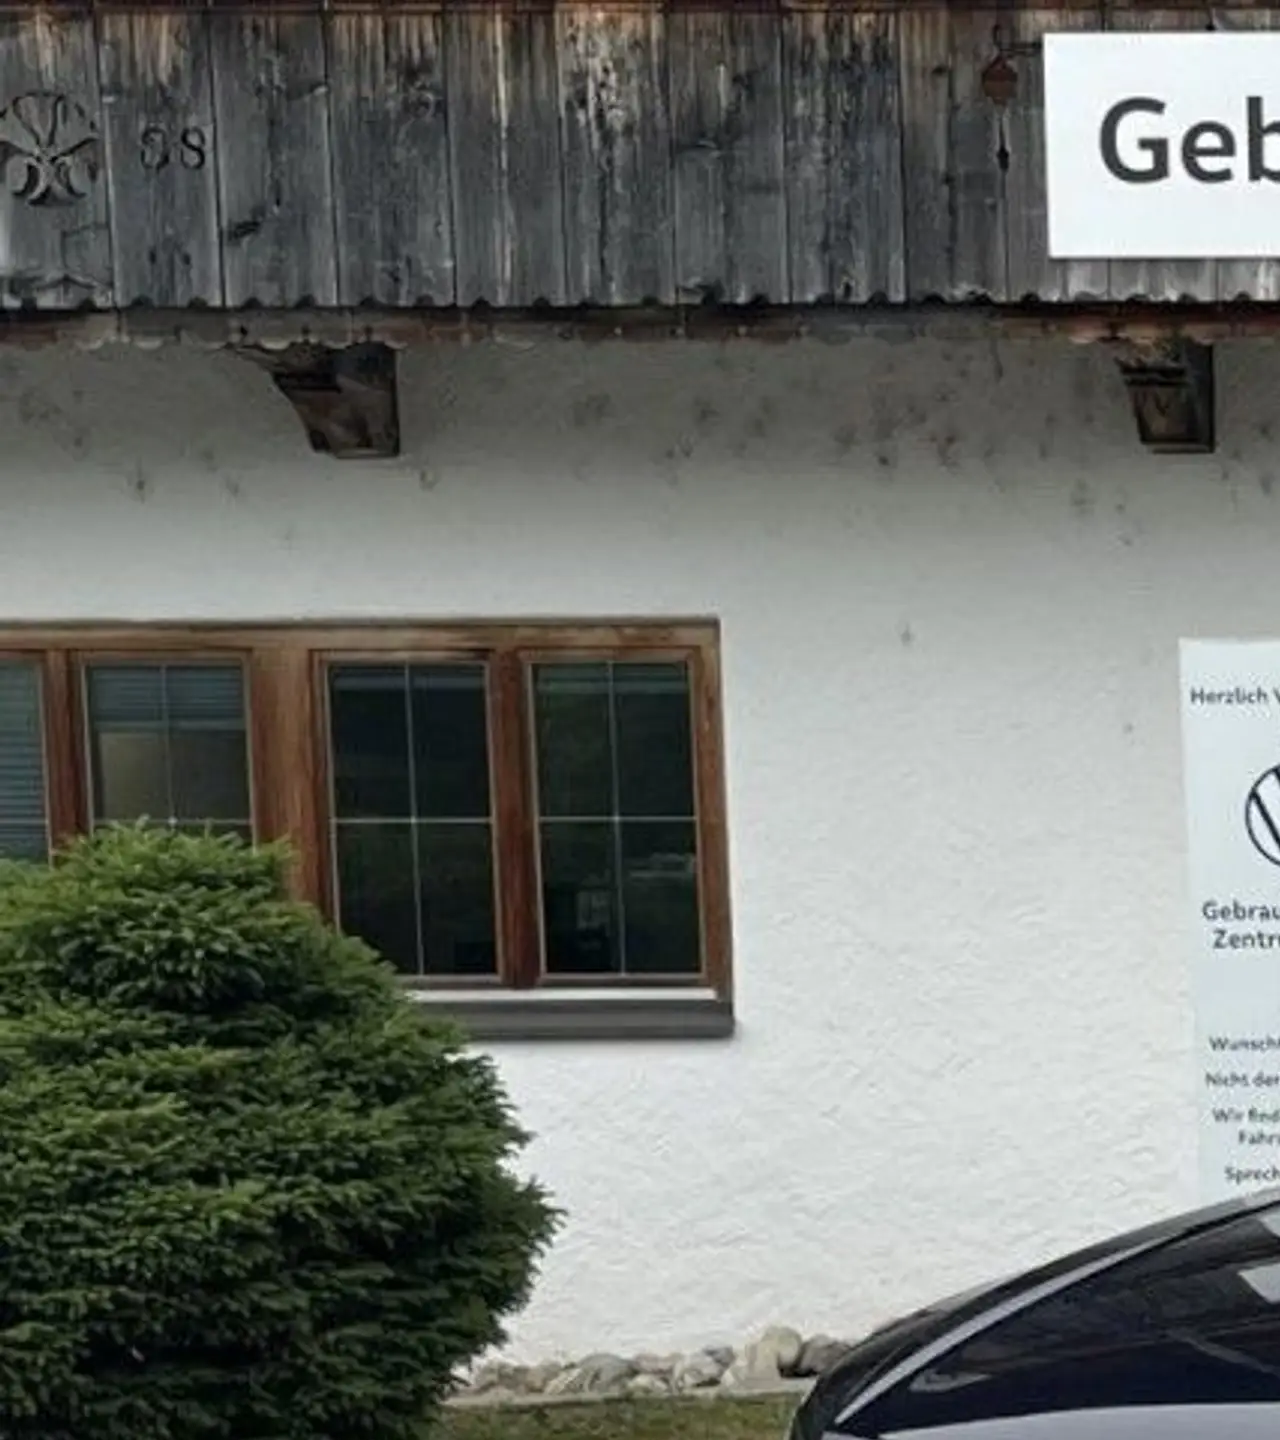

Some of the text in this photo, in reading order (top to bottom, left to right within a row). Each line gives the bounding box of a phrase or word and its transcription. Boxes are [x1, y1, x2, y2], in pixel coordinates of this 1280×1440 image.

[1190, 686, 1268, 705] Herzlich
[1204, 1070, 1249, 1088] Nicht
[1252, 1070, 1280, 1087] der
